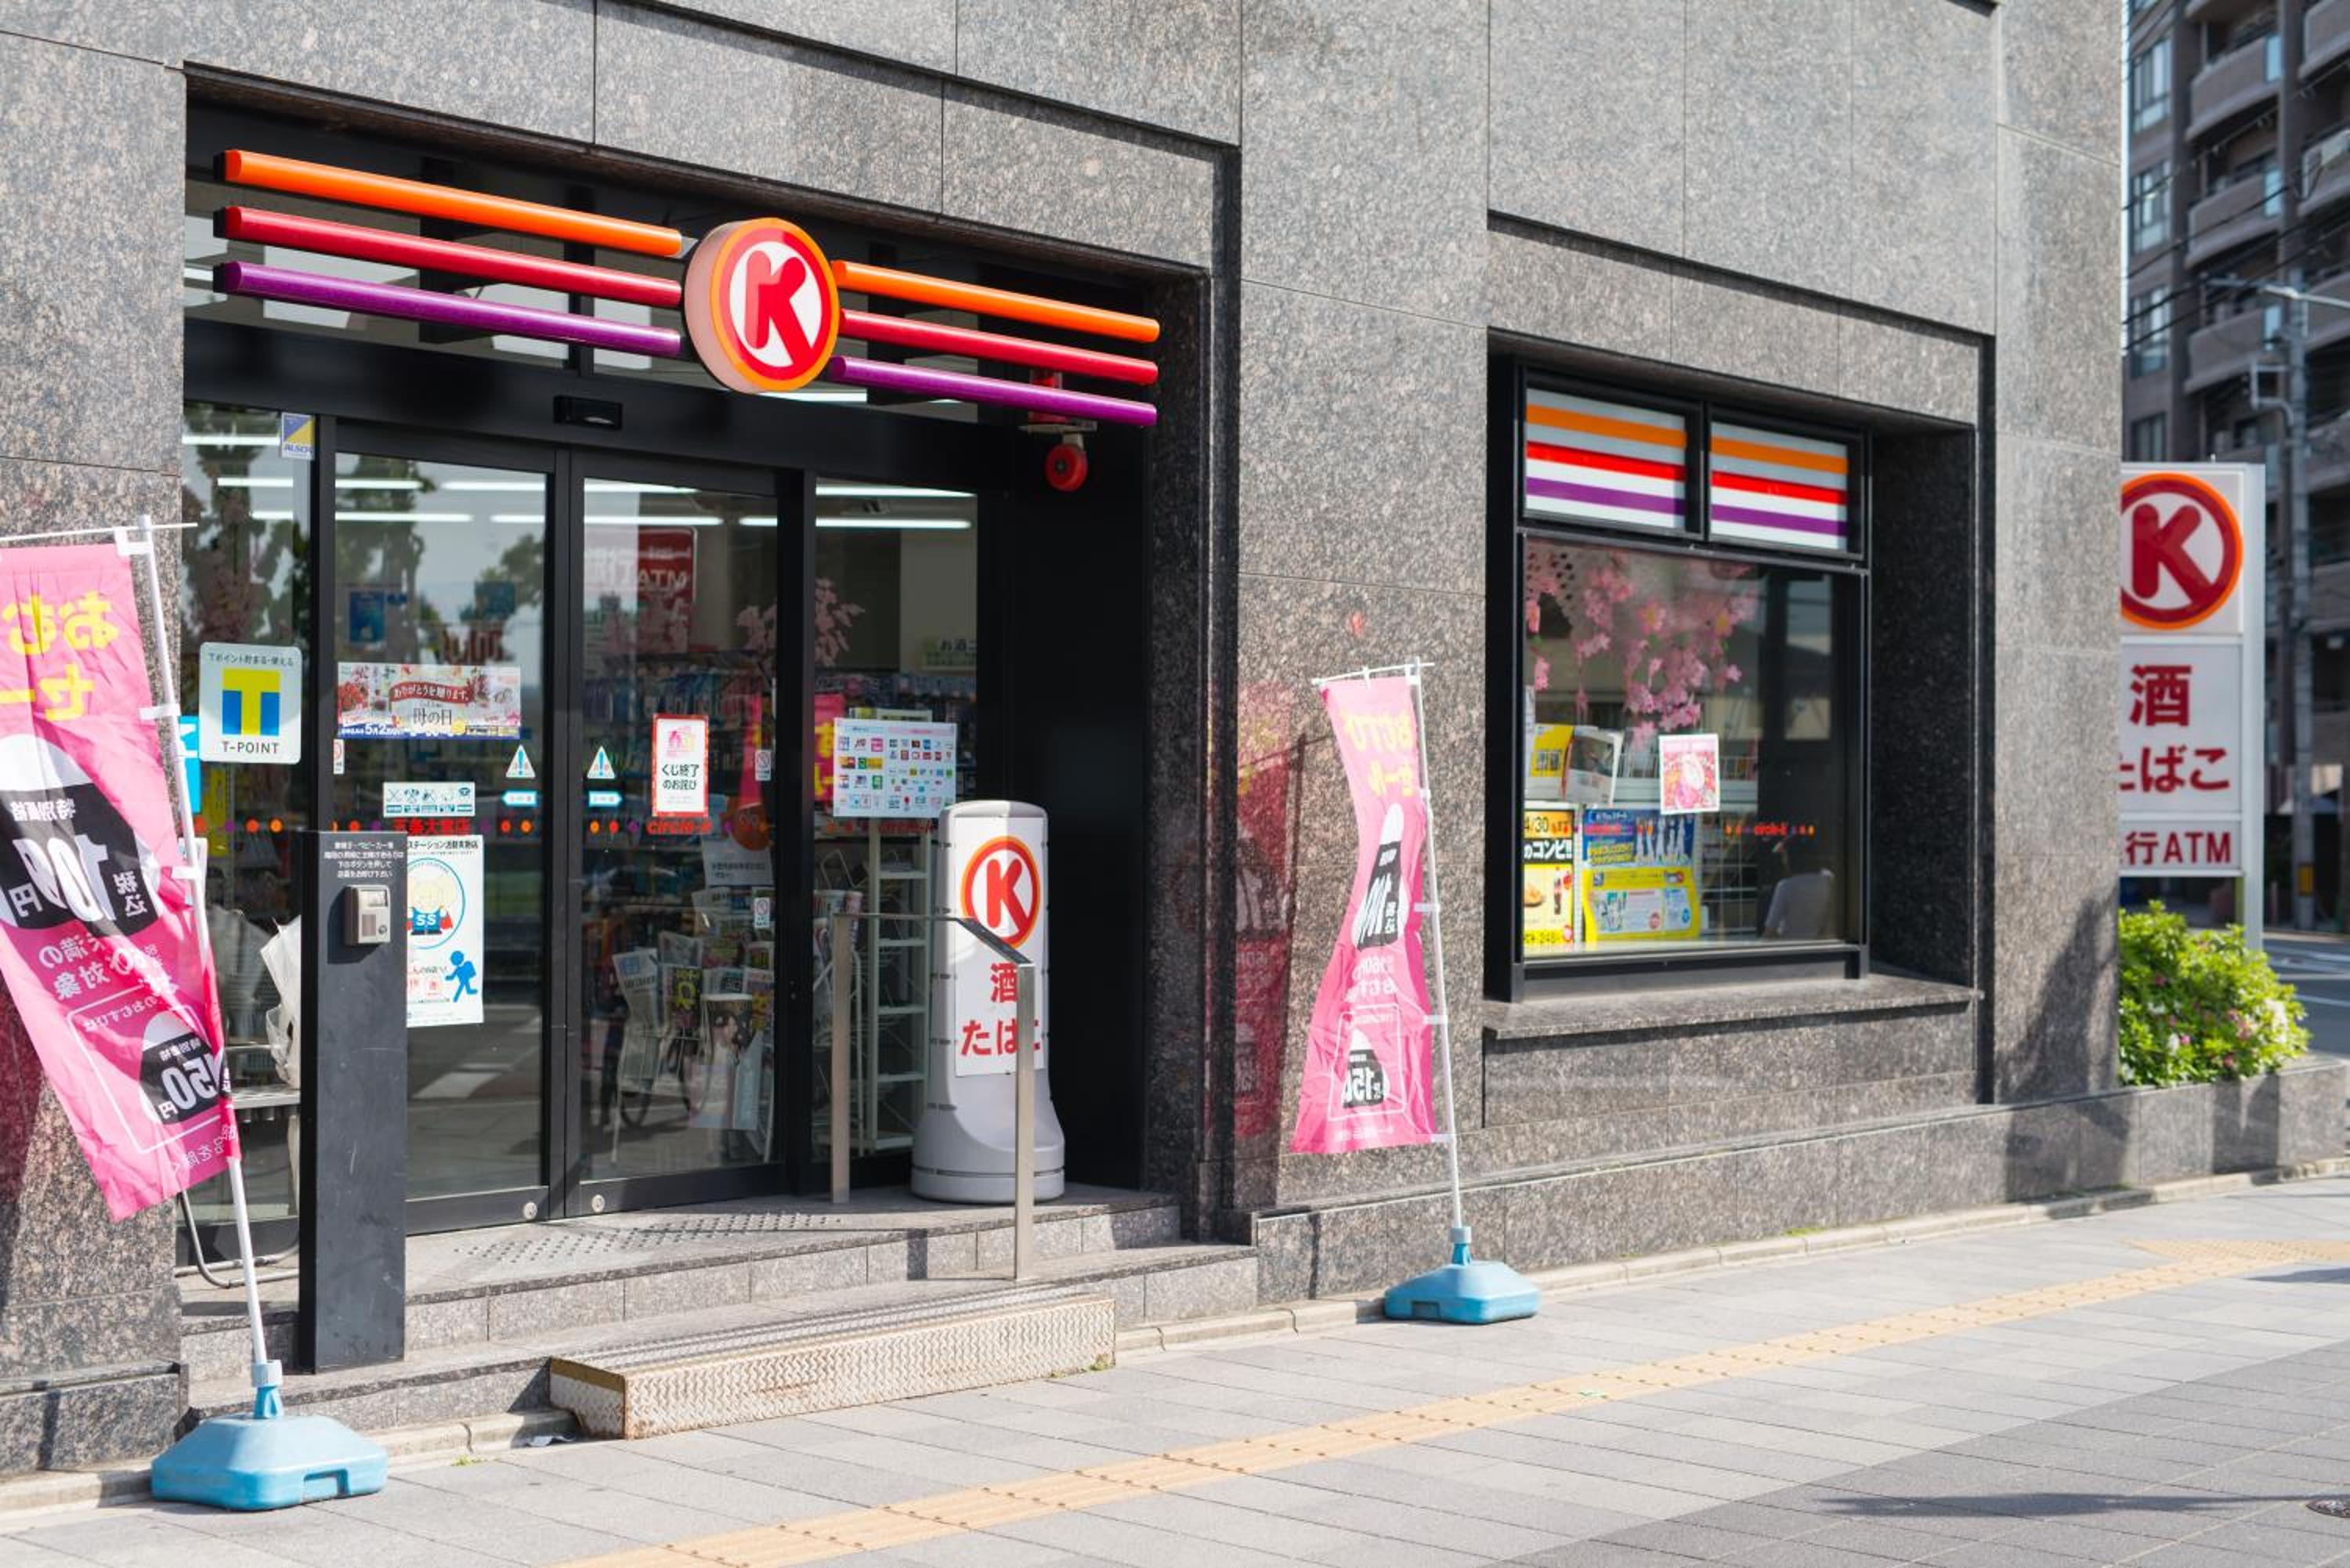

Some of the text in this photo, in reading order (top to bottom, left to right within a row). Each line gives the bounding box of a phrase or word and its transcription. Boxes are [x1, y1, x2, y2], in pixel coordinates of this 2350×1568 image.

[2129, 664, 2193, 727] 酒
[413, 707, 452, 727] 母の日
[222, 741, 279, 754] T-POINT
[661, 764, 700, 778] くじ終了
[2120, 830, 2232, 865] 行ATM
[415, 915, 437, 926] SS
[990, 963, 1018, 1004] 酒
[960, 1019, 1041, 1056] たば
